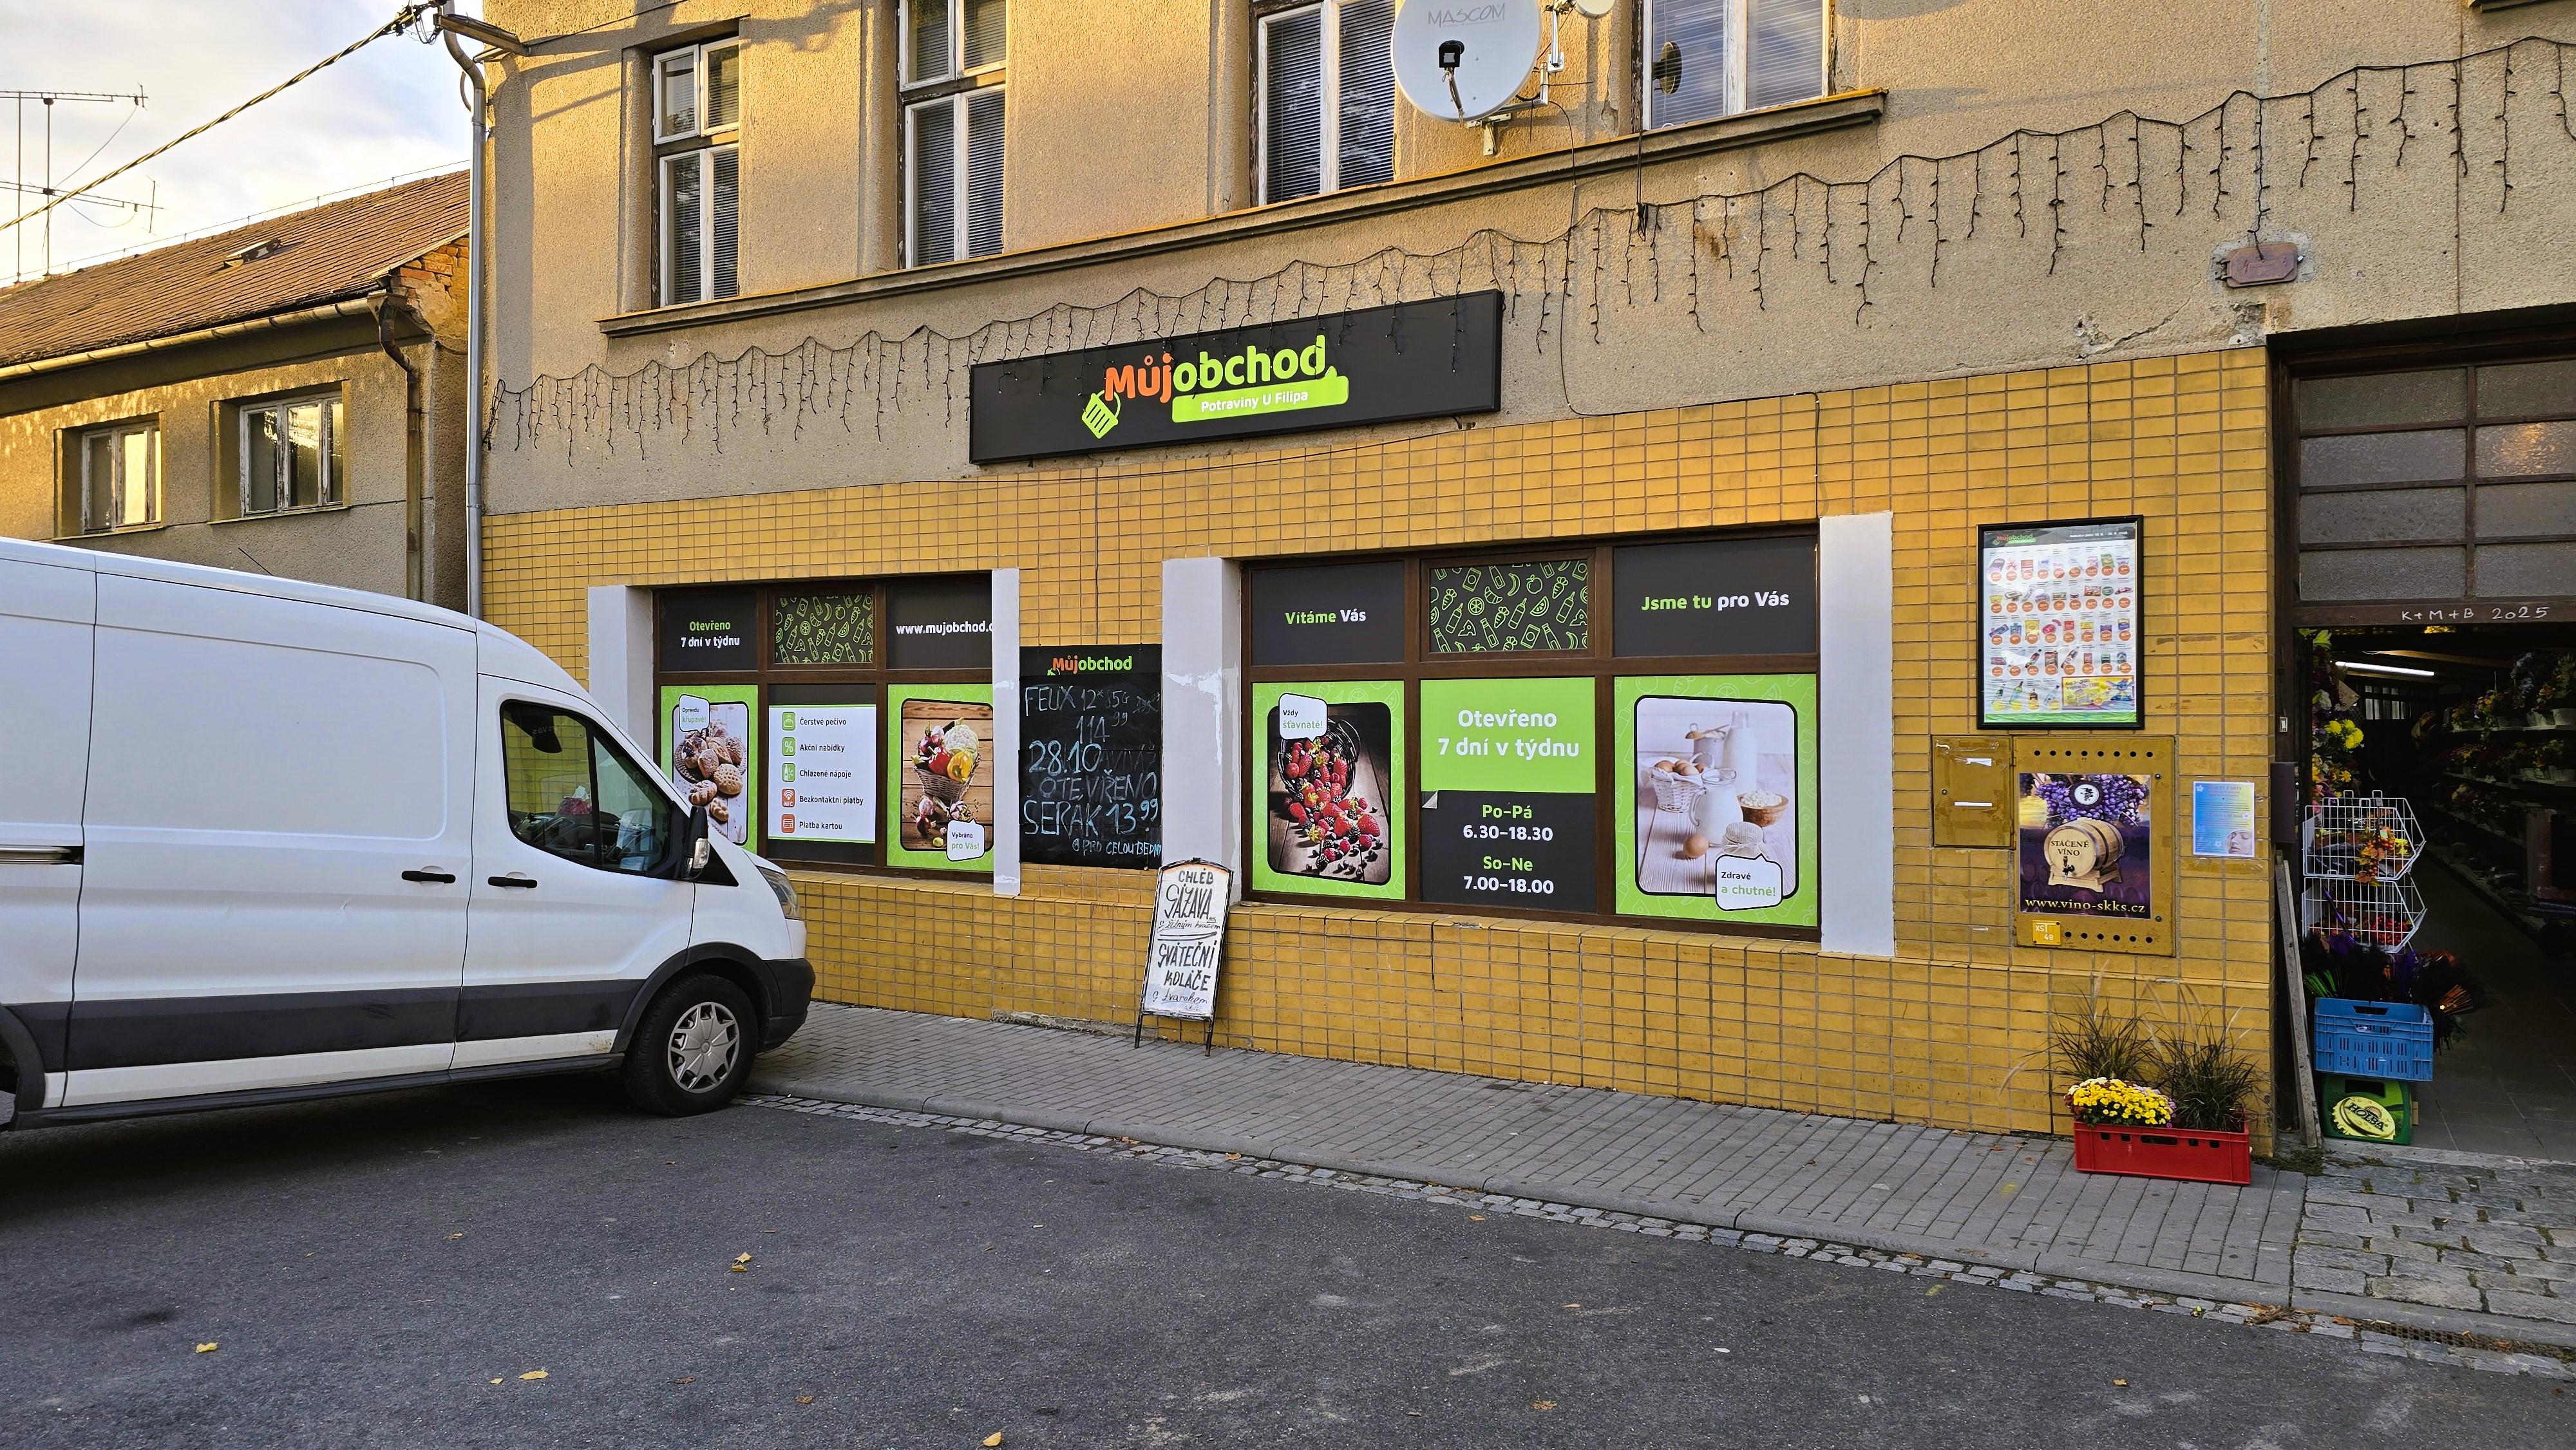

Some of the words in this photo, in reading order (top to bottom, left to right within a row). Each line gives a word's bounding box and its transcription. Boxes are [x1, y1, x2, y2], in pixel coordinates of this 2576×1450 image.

[1428, 3, 1506, 28] MASCOM
[1104, 335, 1325, 403] Můjobchod
[1201, 397, 1259, 412] Potraviny
[1262, 393, 1272, 406] U
[1275, 390, 1309, 405] Filipa
[1642, 596, 1687, 610] Jsme
[1693, 595, 1712, 609] tu
[1718, 596, 1750, 611] pro
[1754, 590, 1790, 607] Vás
[1285, 610, 1336, 625] Vítáme
[1340, 608, 1367, 622] Vás
[2492, 606, 2550, 619] 2025
[689, 620, 731, 631] Otevřeno
[681, 637, 687, 648] 7
[688, 636, 703, 647] dní
[705, 638, 712, 646] v
[713, 635, 740, 648] týdnu
[1052, 655, 1132, 674] Můjobchod
[682, 715, 706, 724] křupavé!
[1282, 709, 1298, 717] Vždy
[1458, 708, 1557, 728] Otevřeno
[800, 717, 824, 726] Čerstvé
[826, 718, 847, 726] pečivo
[1282, 720, 1323, 729] šťavnaté!
[819, 744, 845, 753] nabídky
[1438, 738, 1450, 755] 7
[1456, 737, 1489, 756] dní
[1495, 742, 1509, 756] v
[1515, 738, 1579, 761] týdnu
[829, 770, 851, 779] nápoje
[1039, 769, 1157, 804] OTEVŘENO
[799, 795, 842, 804] Bezkontaktní
[843, 796, 864, 805] platby
[1482, 804, 1533, 819] Po-Pá
[799, 821, 819, 829] Platba
[821, 822, 842, 830] kartou
[1463, 824, 1553, 842] 6.30-18.30
[2050, 839, 2090, 848] STÁČENÉ
[2058, 848, 2080, 856] VÍNO
[1482, 856, 1533, 871] So-Ne
[1178, 867, 1214, 885] CHLÉB
[1721, 871, 1751, 880] Zdravé
[1463, 876, 1554, 894] 7.00-18.00
[1732, 885, 1776, 896] chutné!
[2025, 899, 2145, 913] www.vino-skks.cz
[1158, 940, 1217, 968] SVÁTEČNÍ
[1164, 970, 1211, 991] KOLÁČE
[2347, 1102, 2385, 1131] HOLBA
